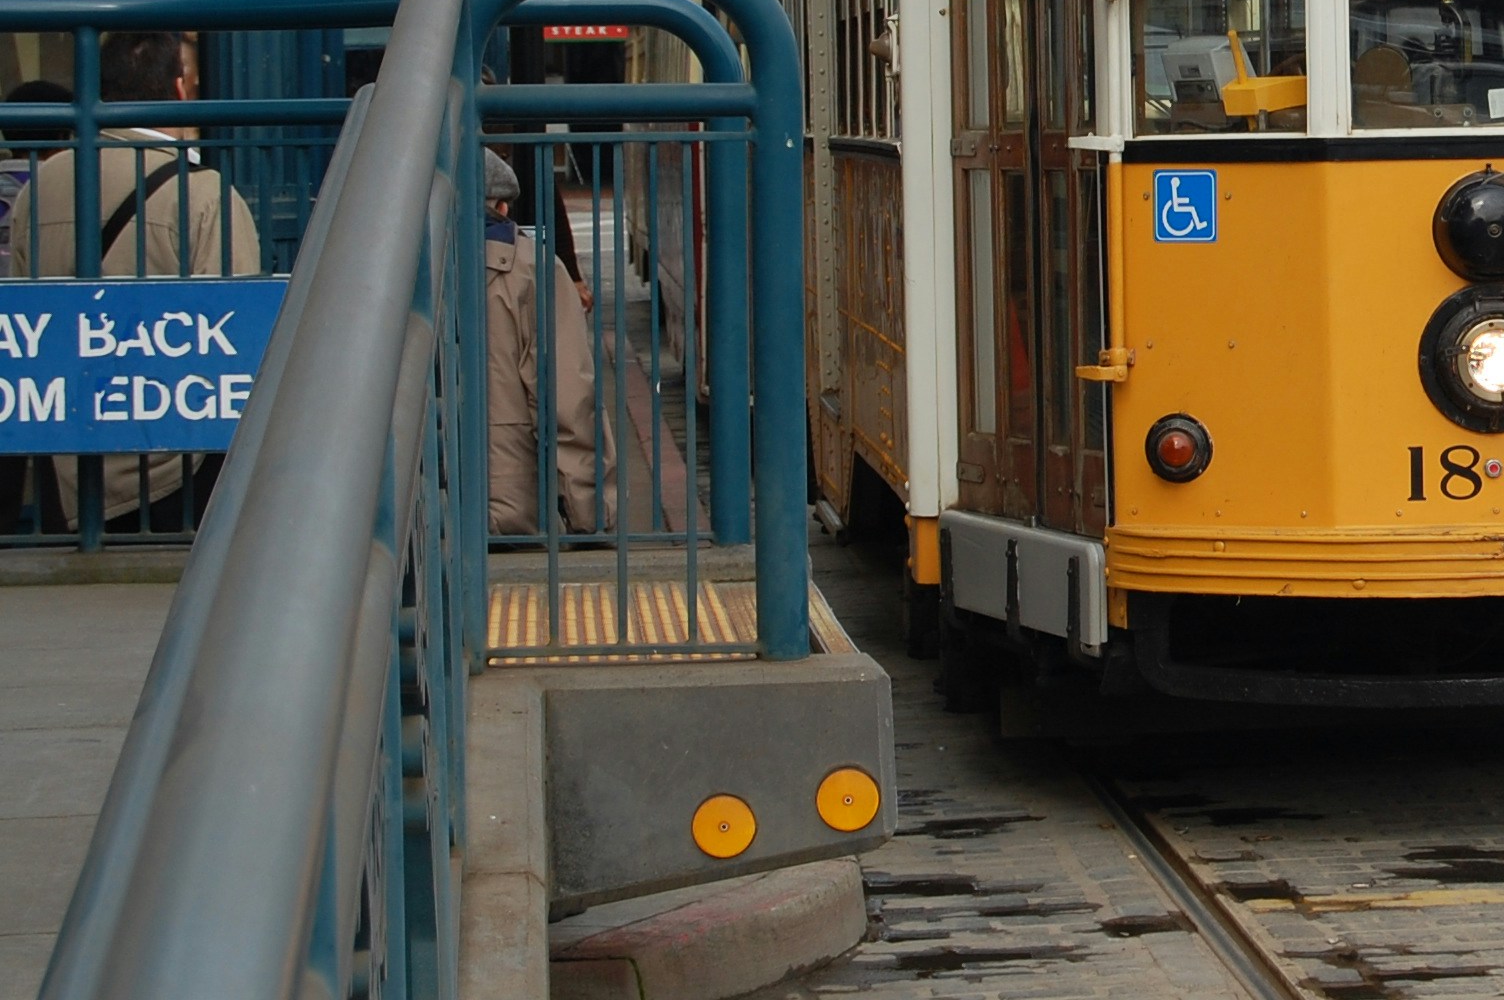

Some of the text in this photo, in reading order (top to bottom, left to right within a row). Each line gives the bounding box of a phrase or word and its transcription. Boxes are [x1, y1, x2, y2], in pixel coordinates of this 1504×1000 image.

[551, 26, 607, 36] STEAK
[78, 310, 238, 358] BACK
[94, 374, 255, 421] EDGE
